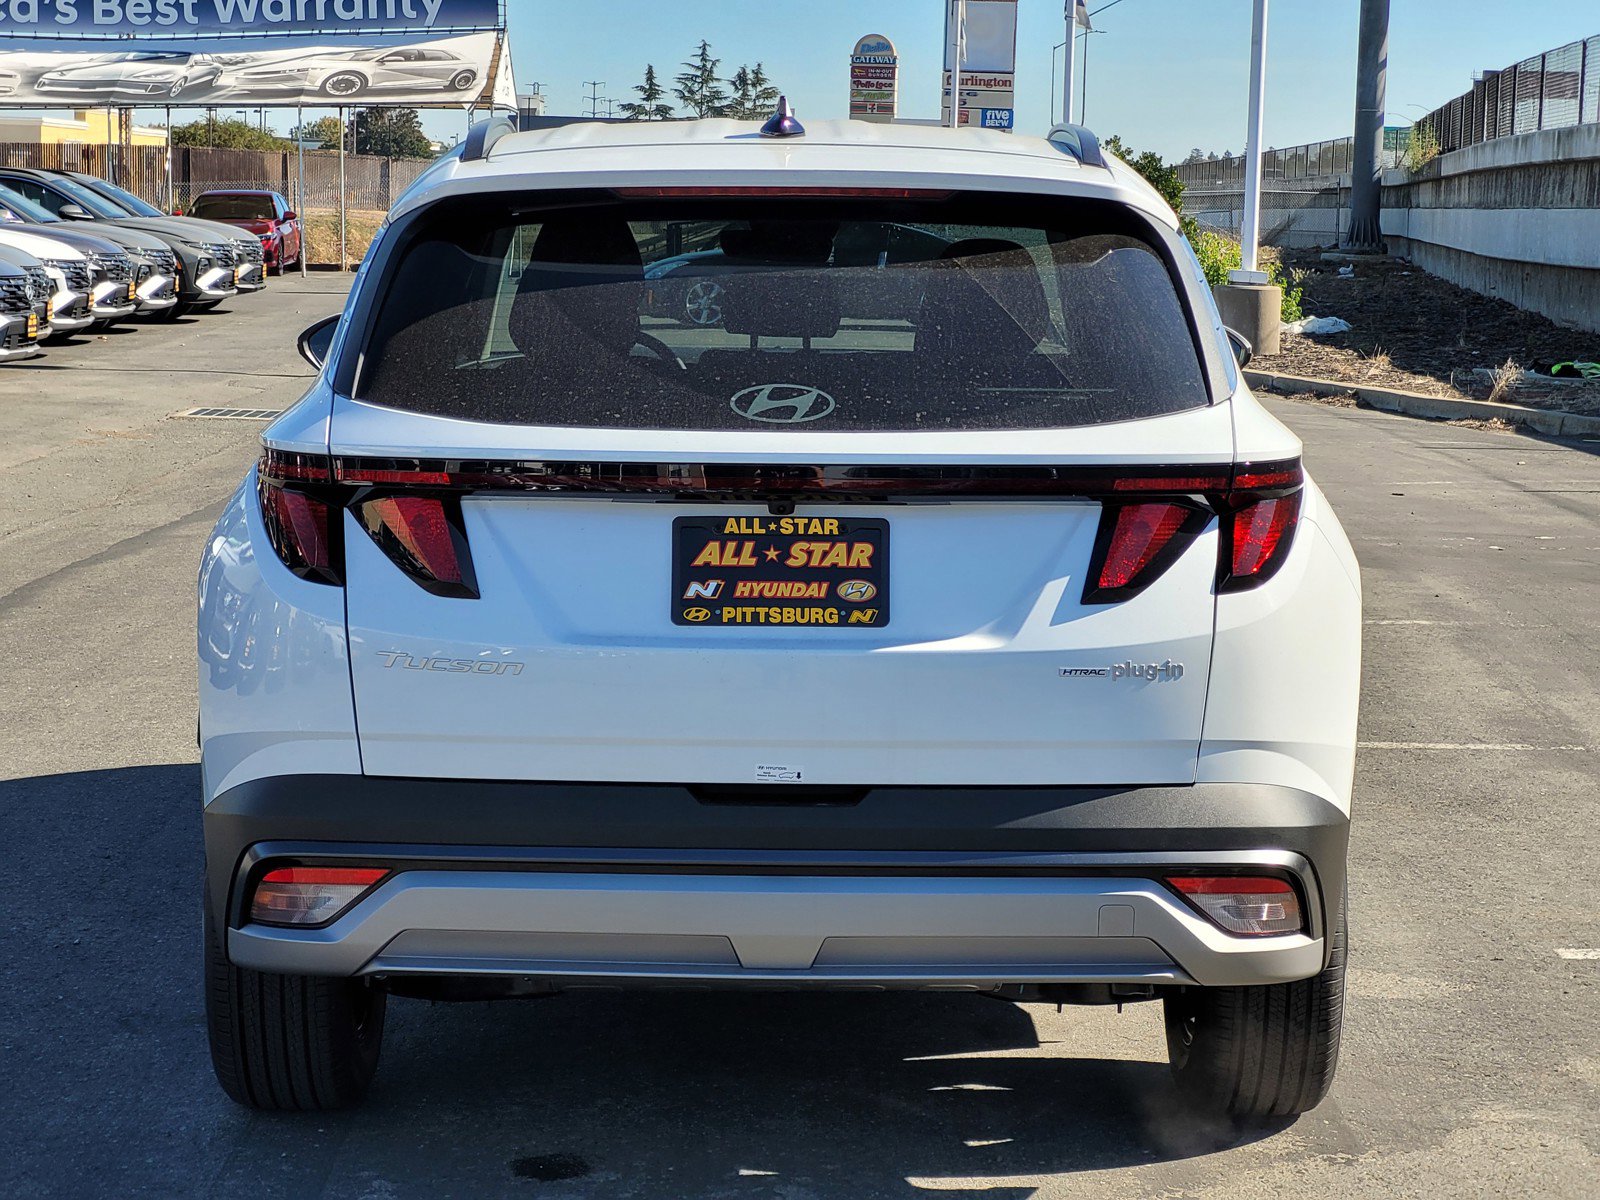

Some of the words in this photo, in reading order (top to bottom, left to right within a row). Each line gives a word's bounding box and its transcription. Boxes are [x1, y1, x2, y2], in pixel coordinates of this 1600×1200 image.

[0, 0, 78, 25] as
[93, 0, 199, 26] Best
[212, 0, 443, 27] Warranty
[853, 55, 895, 64] GATEWAY
[875, 81, 894, 89] Loco
[986, 110, 1010, 120] five
[986, 119, 1009, 127] BELOW
[723, 518, 766, 534] ALL
[779, 518, 839, 535] STAR
[690, 540, 759, 567] ALL
[784, 541, 875, 568] STAR
[732, 580, 831, 599] HYUNDAI
[722, 607, 839, 624] PITTSBURG
[1062, 668, 1107, 676] HTRAC
[1111, 659, 1184, 681] plug-in
